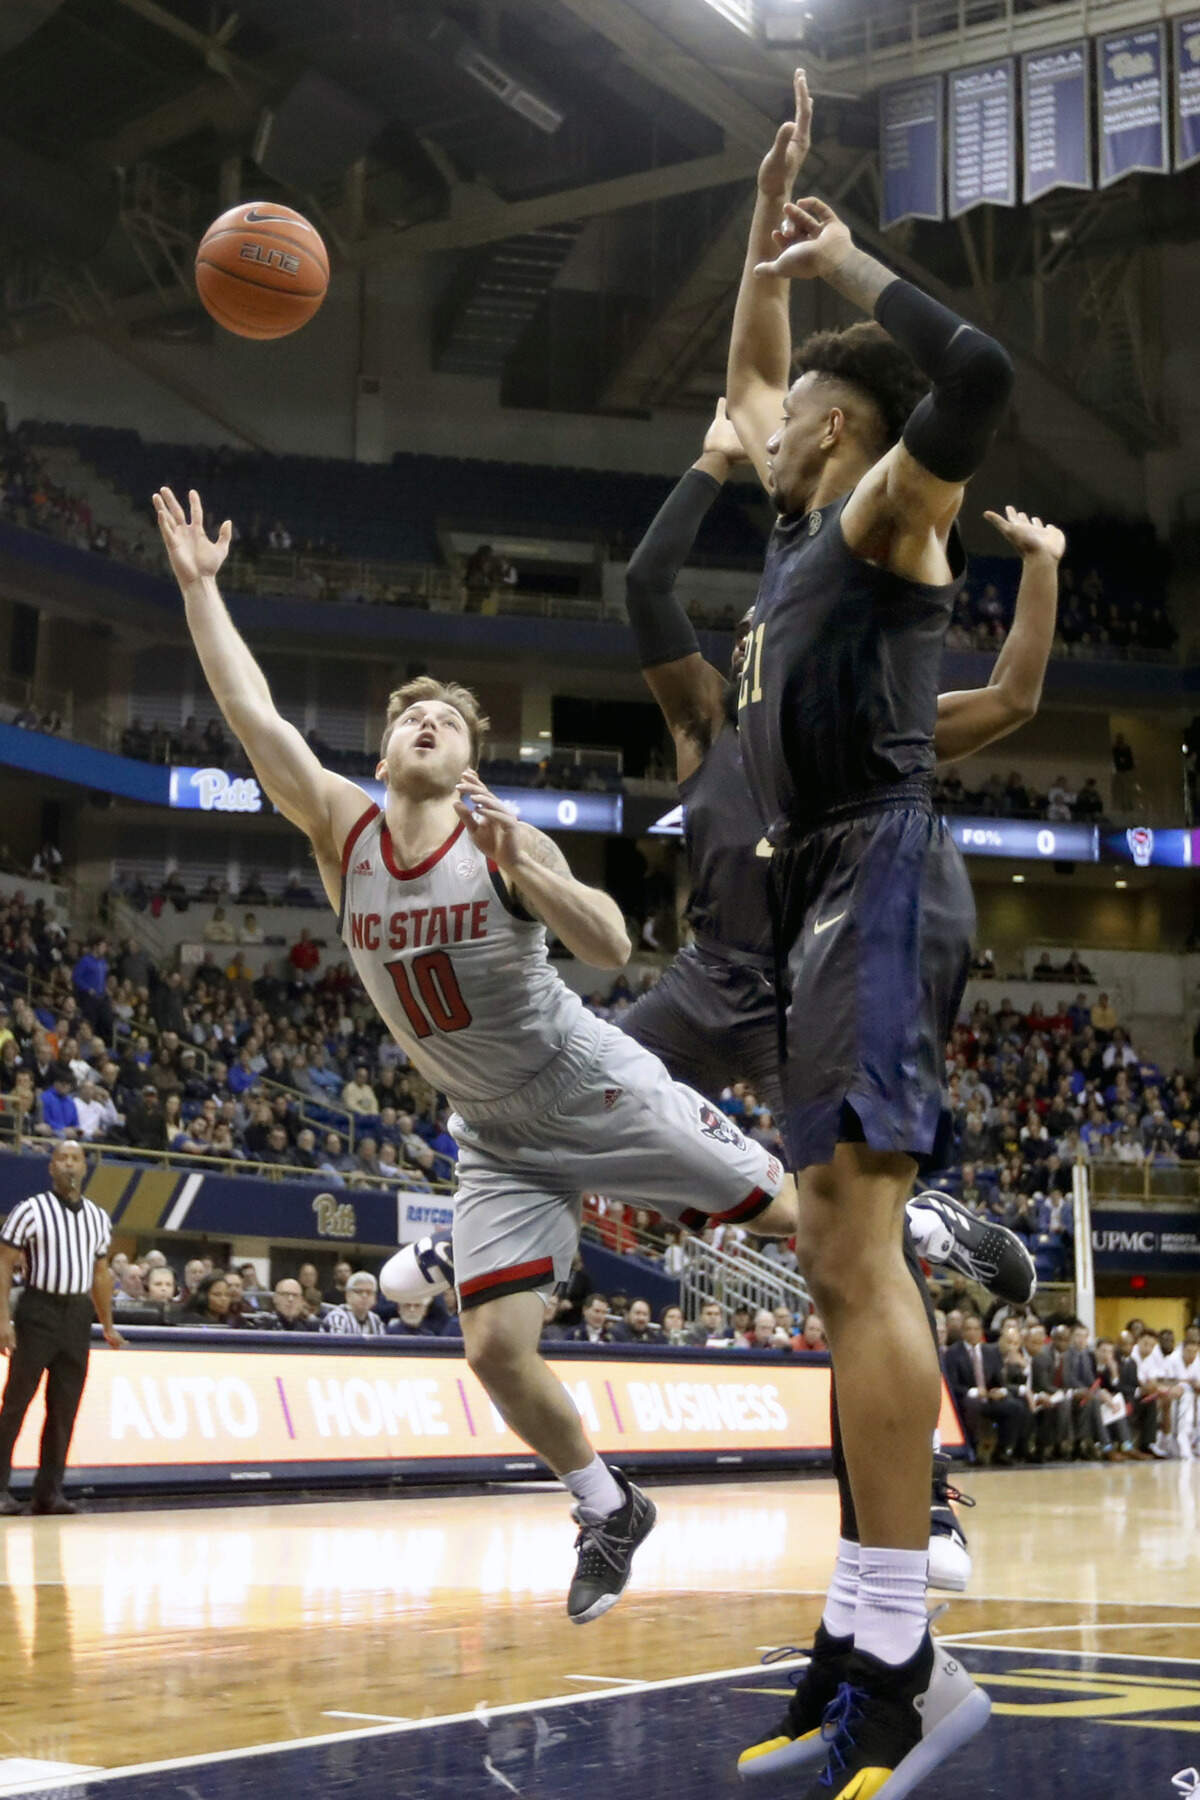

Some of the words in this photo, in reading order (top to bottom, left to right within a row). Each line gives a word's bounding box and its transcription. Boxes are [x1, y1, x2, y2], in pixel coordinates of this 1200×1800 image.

[240, 242, 300, 276] ELITE
[191, 767, 262, 812] Pitt
[557, 799, 578, 825] 0
[962, 828, 1003, 846] FG%
[1036, 829, 1055, 855] 0
[351, 912, 381, 950] NC
[388, 900, 490, 950] STATE
[384, 951, 473, 1039] 10
[312, 1193, 357, 1238] Pitt
[1092, 1230, 1155, 1253] UPMC
[110, 1376, 259, 1440] AUTO
[307, 1378, 449, 1437] HOME
[627, 1381, 788, 1432] BUSINESS
